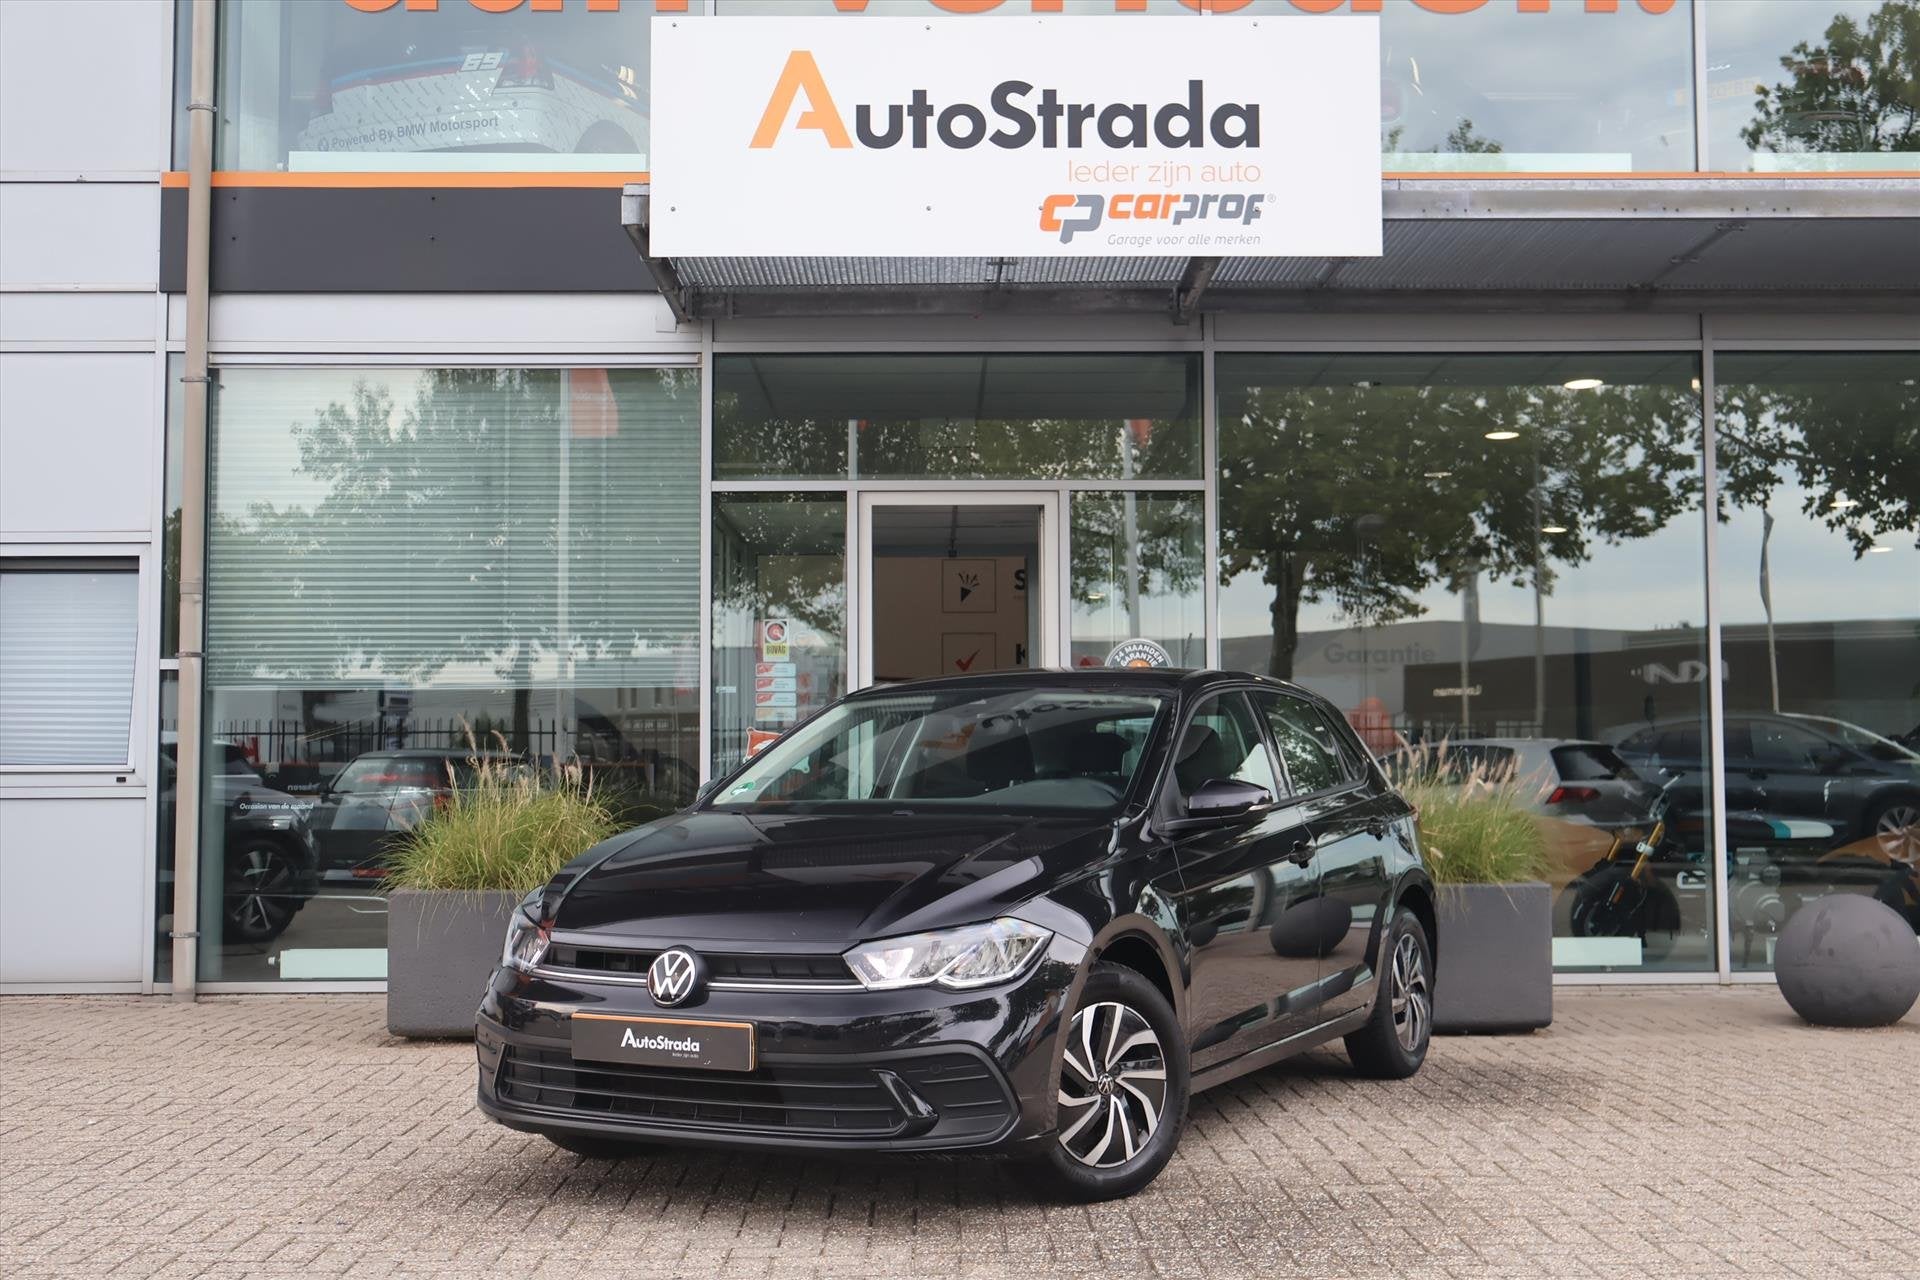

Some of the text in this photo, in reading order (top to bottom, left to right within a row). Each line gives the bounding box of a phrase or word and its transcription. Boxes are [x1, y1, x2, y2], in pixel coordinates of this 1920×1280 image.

[749, 50, 1261, 150] AutoStrada
[331, 115, 499, 149] Powered By BMW Motorsport
[1068, 160, 1261, 188] Ieder zijn auto
[1107, 233, 1261, 247] Garage voor alle merken
[1114, 644, 1164, 663] 24 MAANDEN
[1120, 652, 1159, 667] GARANTIE
[1324, 642, 1434, 664] Garantie
[620, 1028, 700, 1052] AutoStrada
